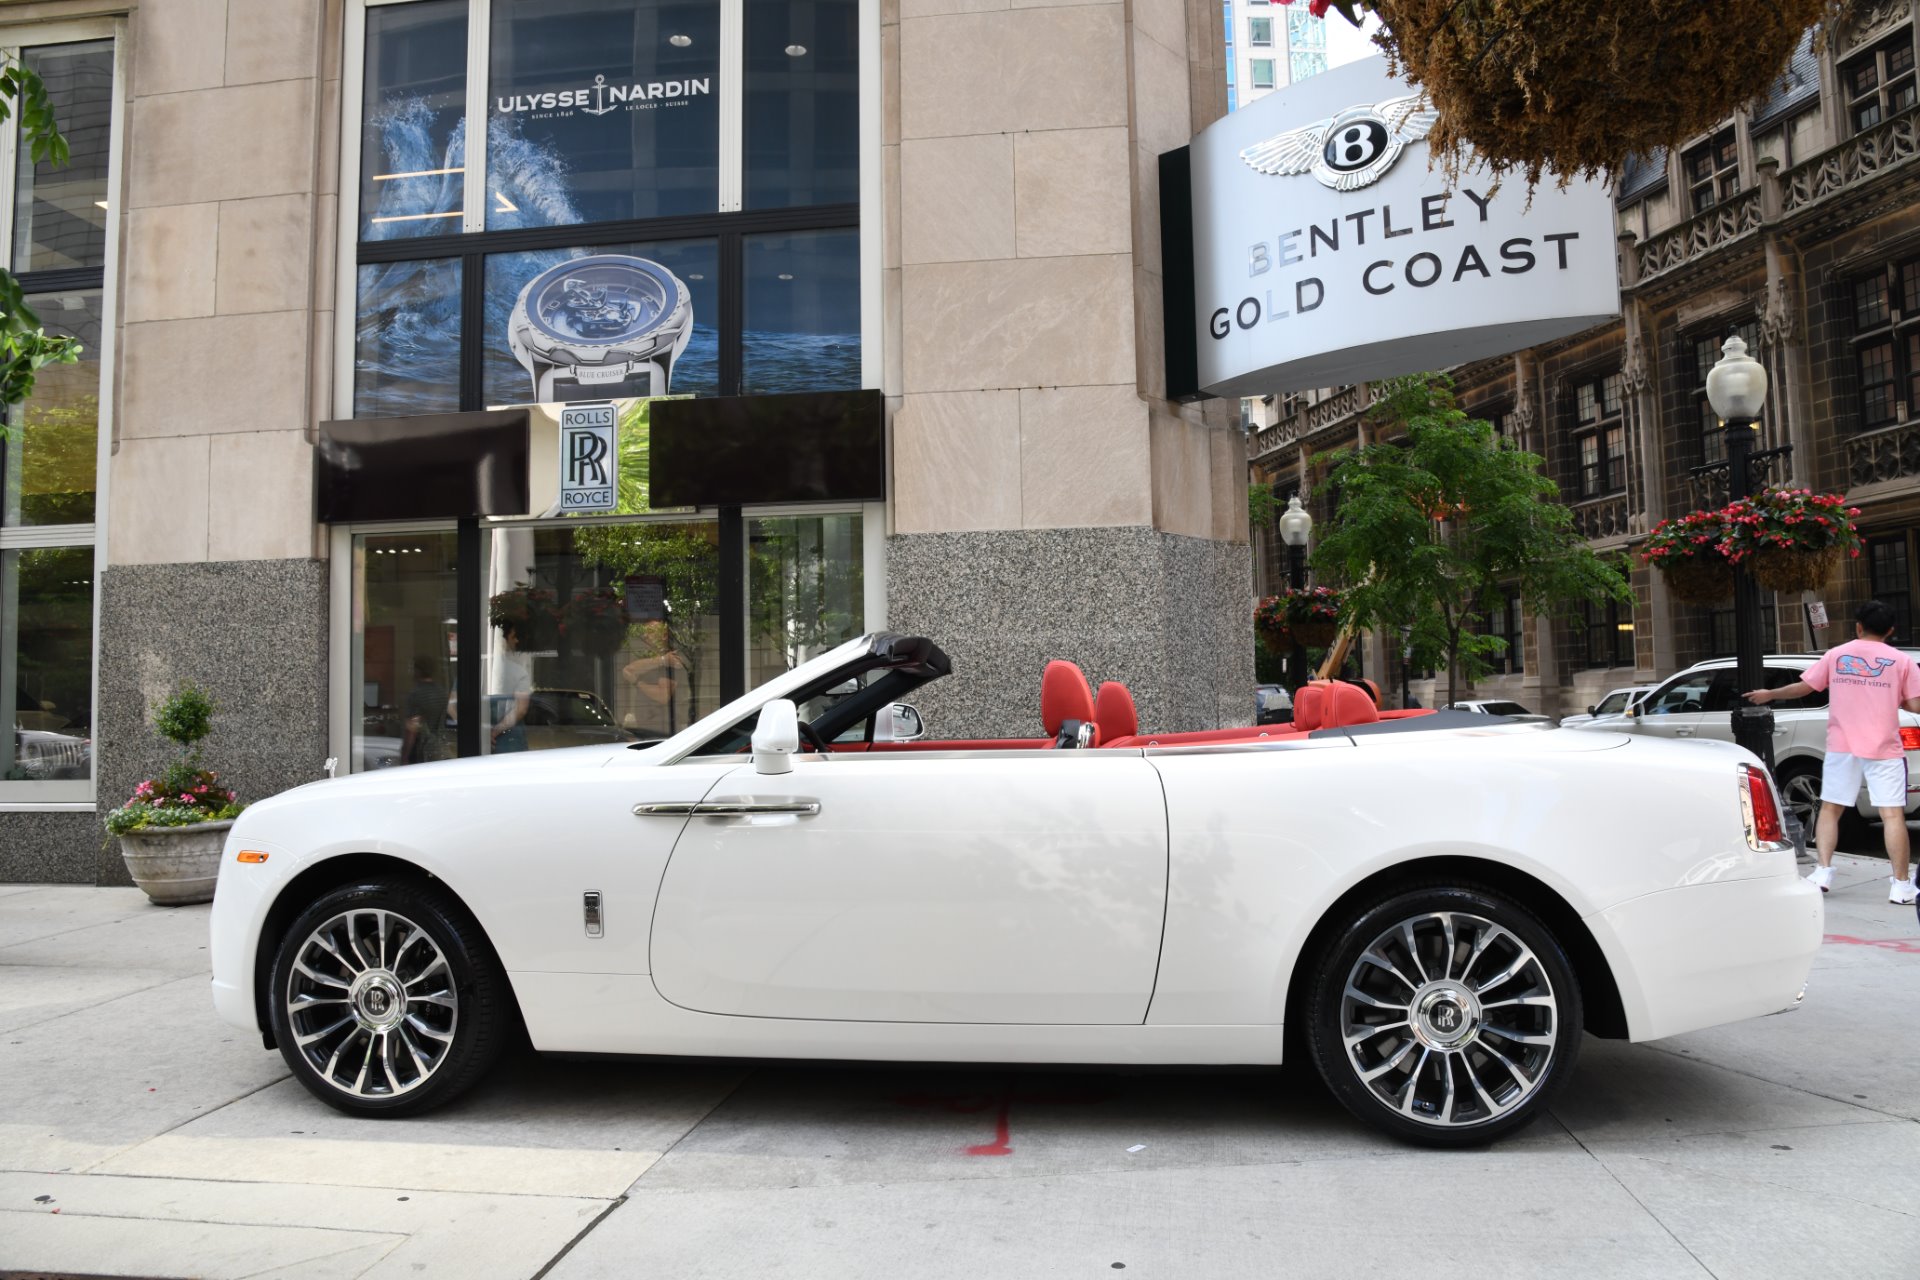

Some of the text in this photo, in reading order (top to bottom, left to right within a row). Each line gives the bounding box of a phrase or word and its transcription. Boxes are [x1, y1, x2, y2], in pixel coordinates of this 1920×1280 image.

[498, 78, 710, 113] ULYSSE NARDIN
[1333, 124, 1374, 167] B
[1248, 188, 1497, 278] BENTLEY
[1209, 231, 1580, 340] GOLD COAST
[565, 411, 610, 425] ROLLS
[564, 491, 609, 504] ROYCE
[1831, 676, 1892, 688] vineyard vines
